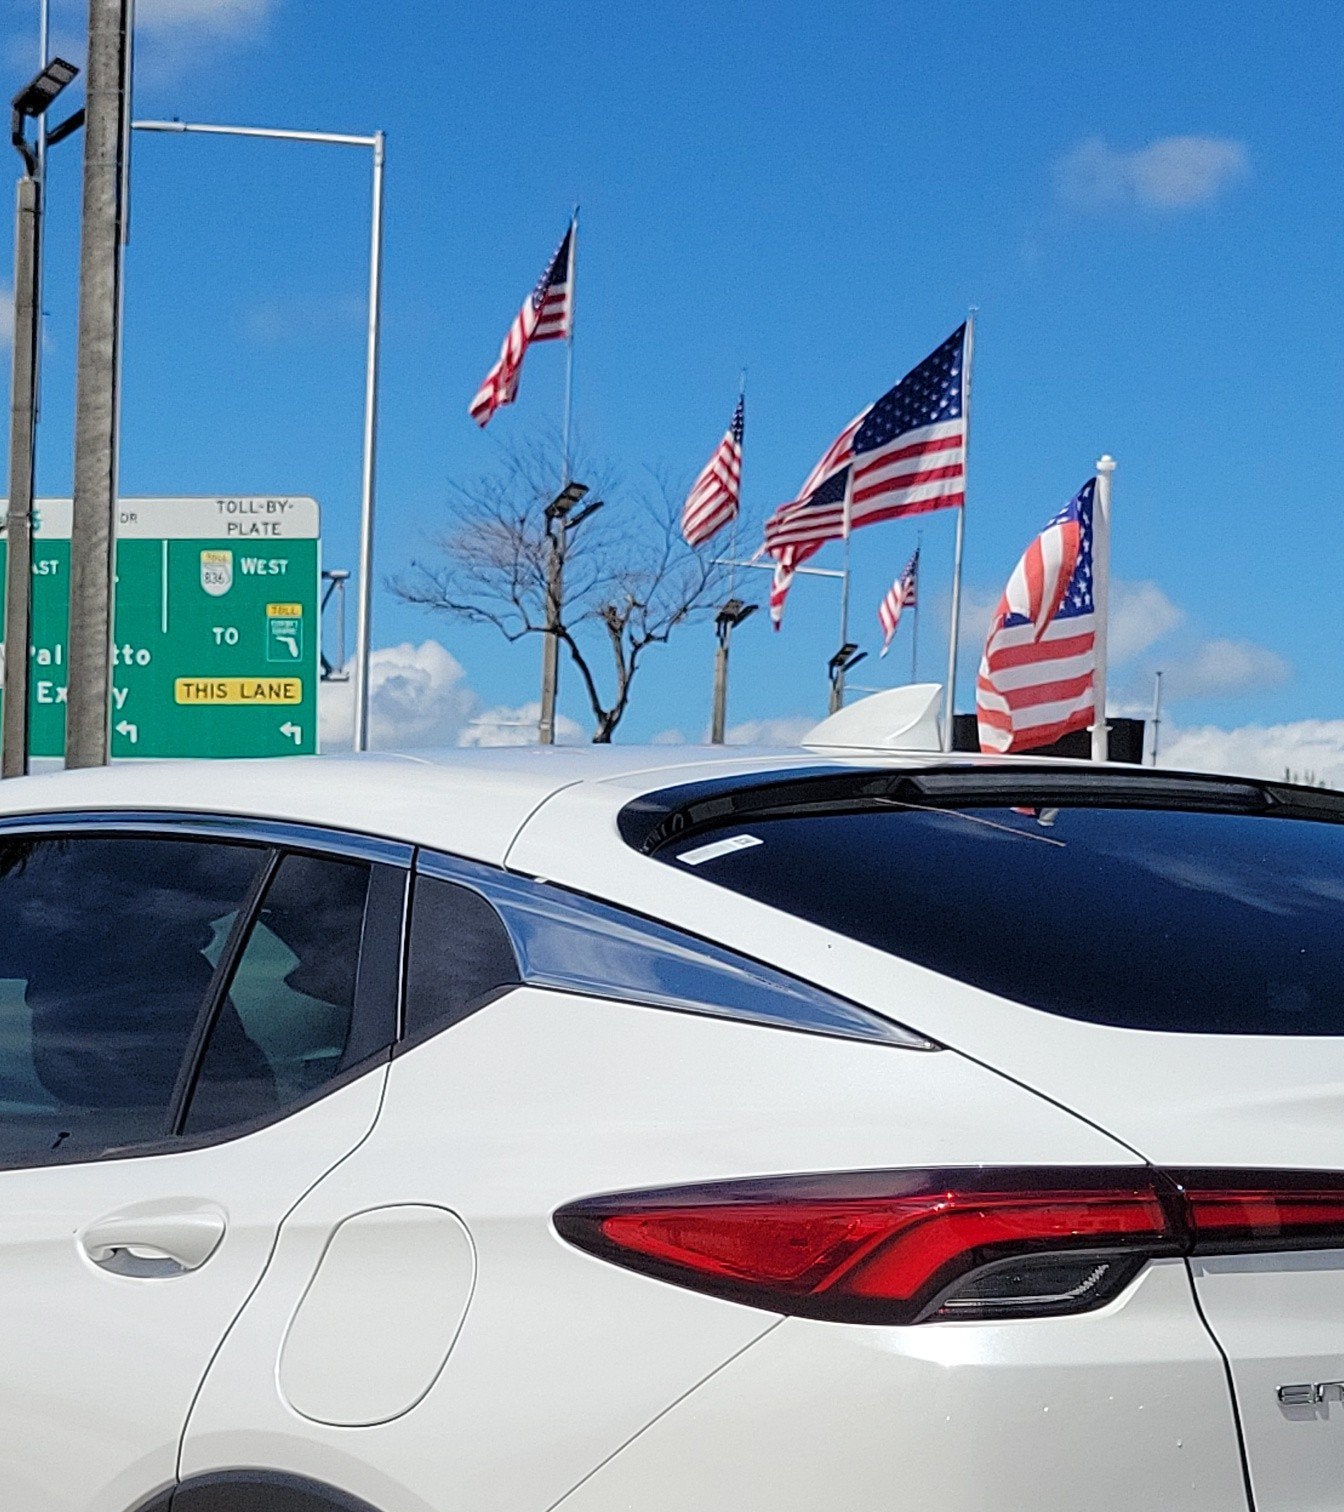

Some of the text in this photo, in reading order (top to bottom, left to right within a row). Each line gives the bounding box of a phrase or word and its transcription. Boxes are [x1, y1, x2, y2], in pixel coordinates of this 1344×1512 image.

[227, 522, 282, 536] PLATE
[240, 557, 288, 575] WEST
[212, 626, 239, 645] TO
[183, 683, 295, 699] THIS LANE
